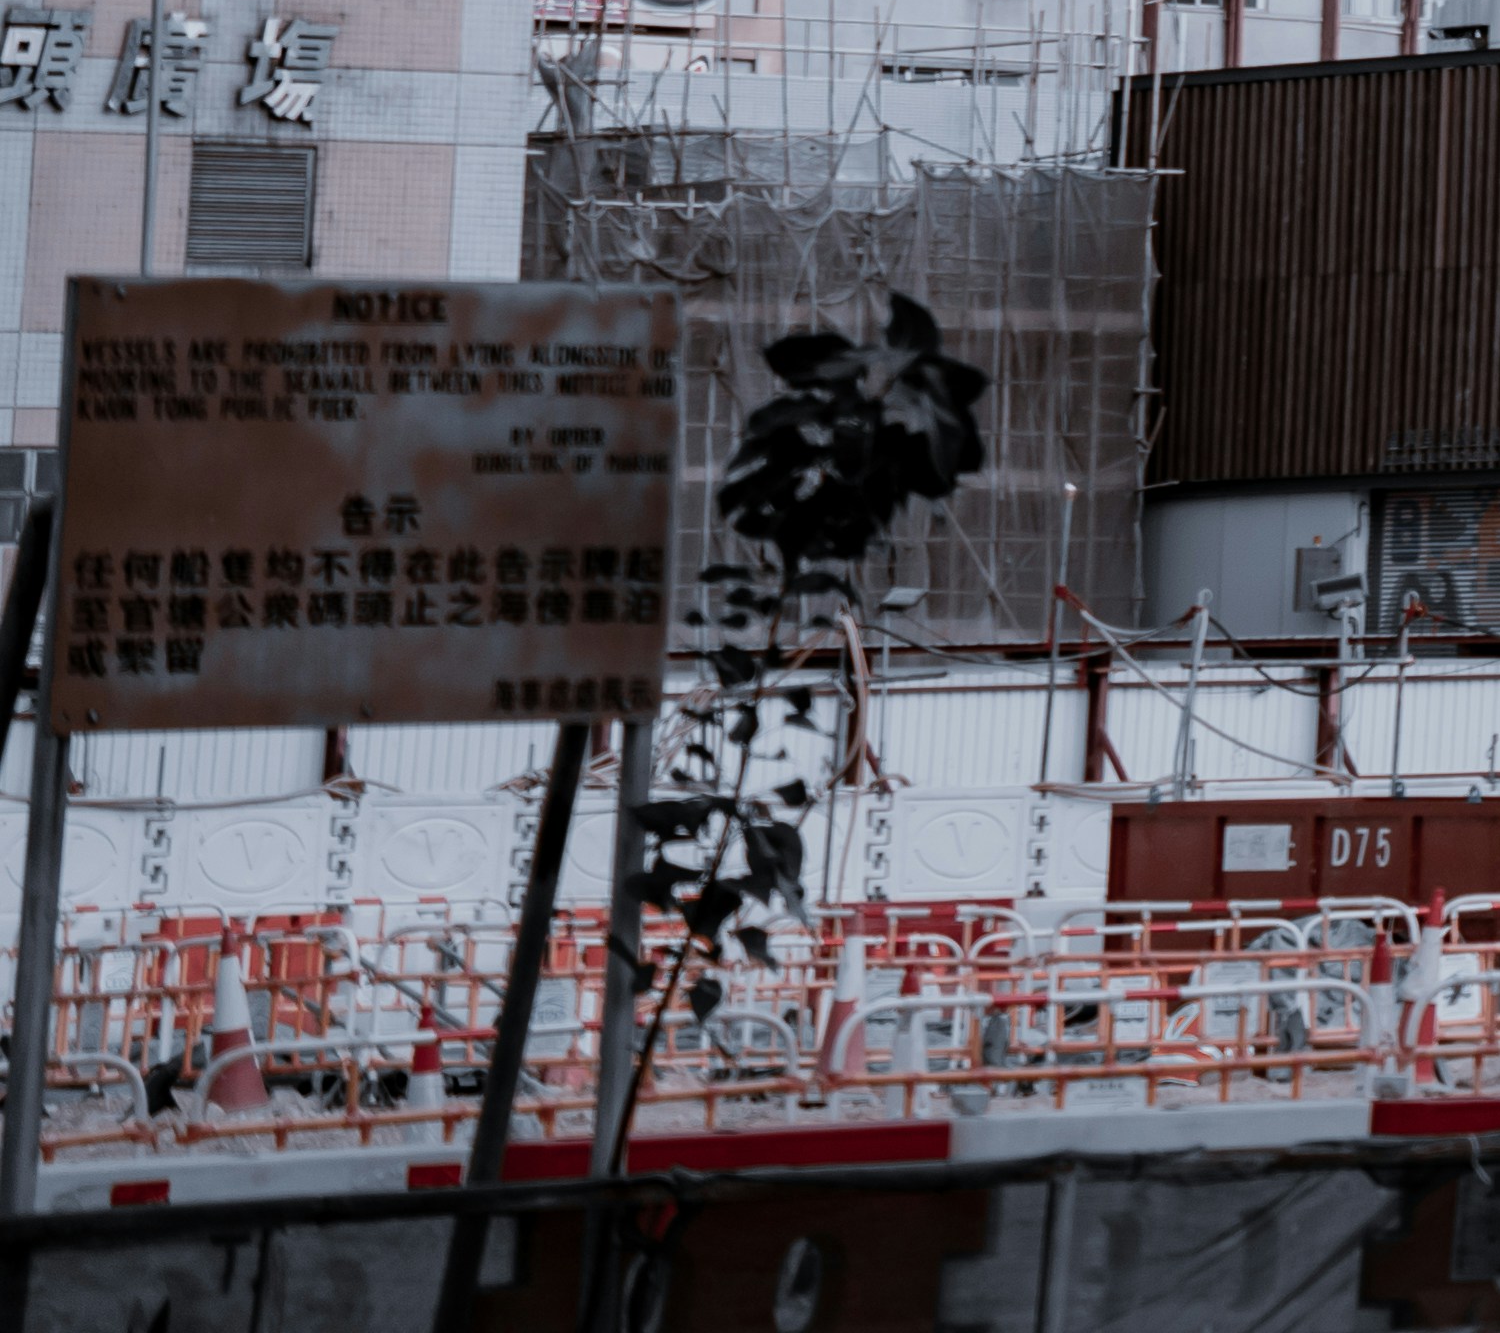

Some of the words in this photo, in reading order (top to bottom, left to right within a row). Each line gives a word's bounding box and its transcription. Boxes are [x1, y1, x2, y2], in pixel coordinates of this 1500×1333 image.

[332, 292, 447, 322] NOTICE
[340, 493, 422, 535] 告示
[1331, 828, 1391, 868] D75
